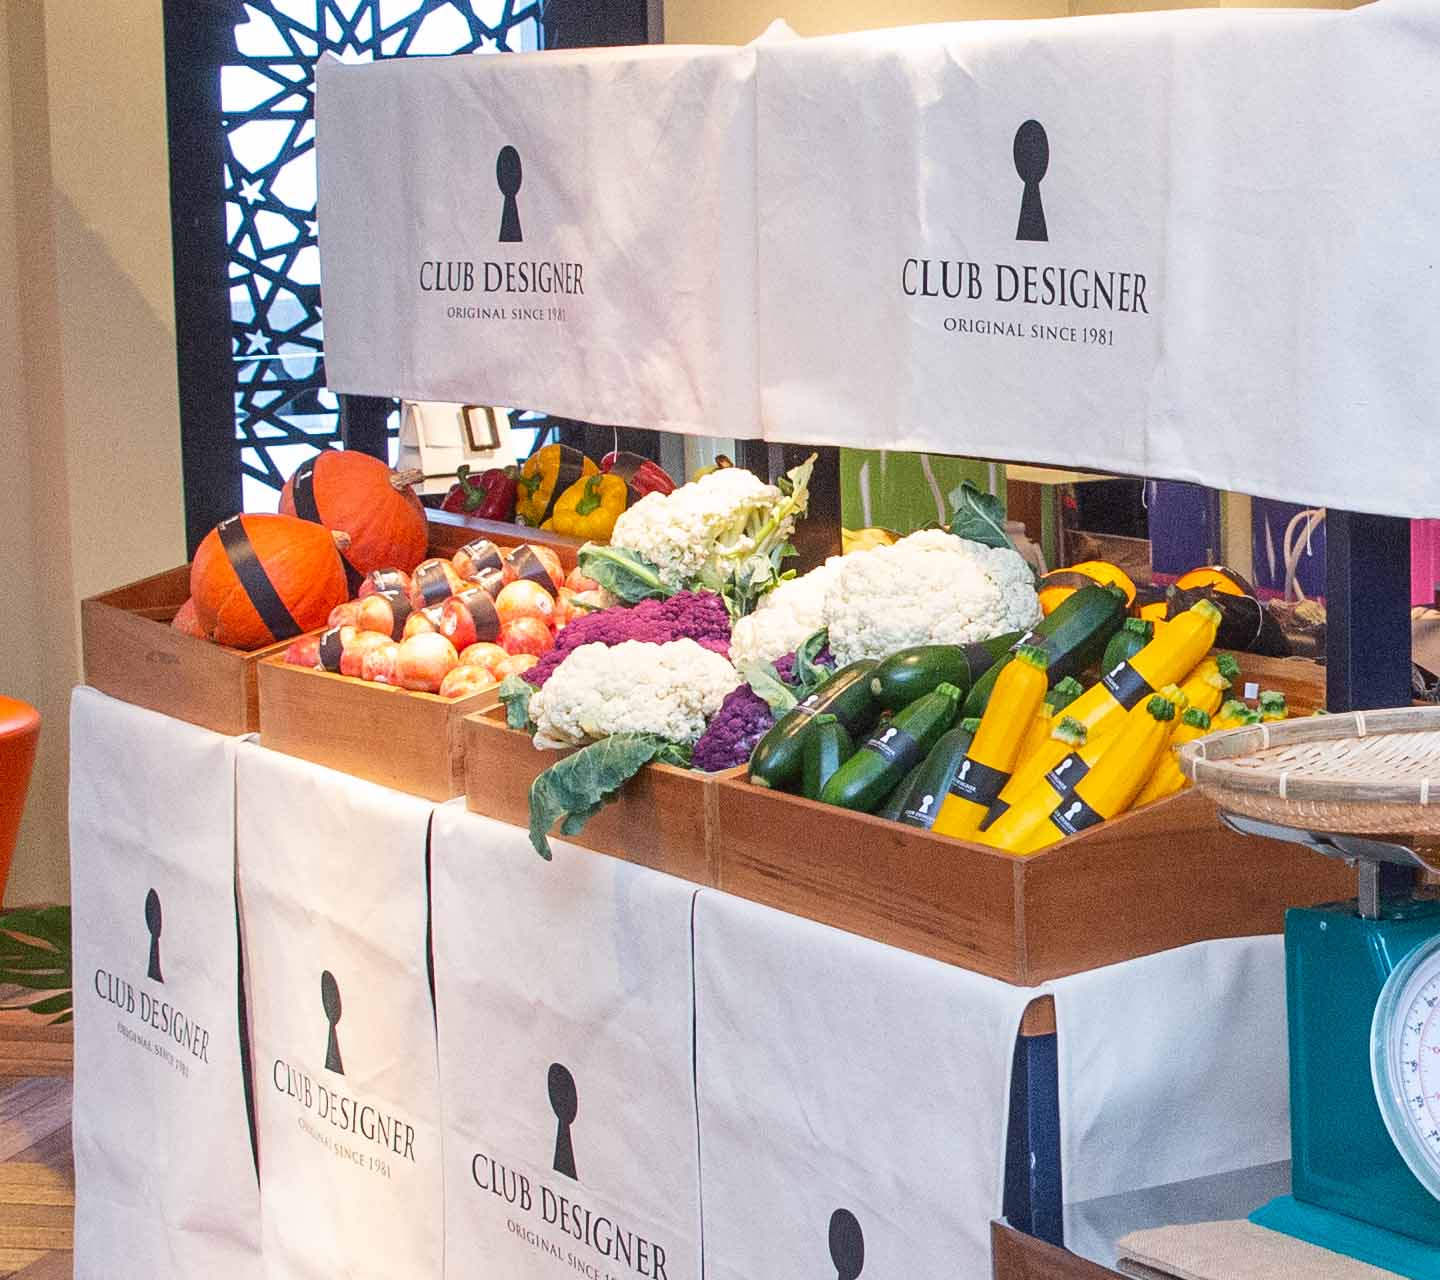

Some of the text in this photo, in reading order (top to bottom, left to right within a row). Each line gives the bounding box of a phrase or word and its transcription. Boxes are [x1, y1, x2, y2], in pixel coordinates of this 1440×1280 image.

[419, 261, 585, 295] CLUB DESIGNER
[902, 258, 1150, 314] CLUB DESIGNER
[447, 306, 567, 321] ORIGINAL SINCE 1981
[943, 317, 1114, 346] ORIGINAL SINCE 1981
[95, 968, 209, 1064] CLUB DESIGNER
[273, 1059, 416, 1163] CLUB DESIGNER
[334, 1143, 366, 1167] SINCE
[368, 1156, 392, 1179] 1981
[472, 1152, 532, 1211] CLUB
[506, 1219, 564, 1262] ORIGINAL
